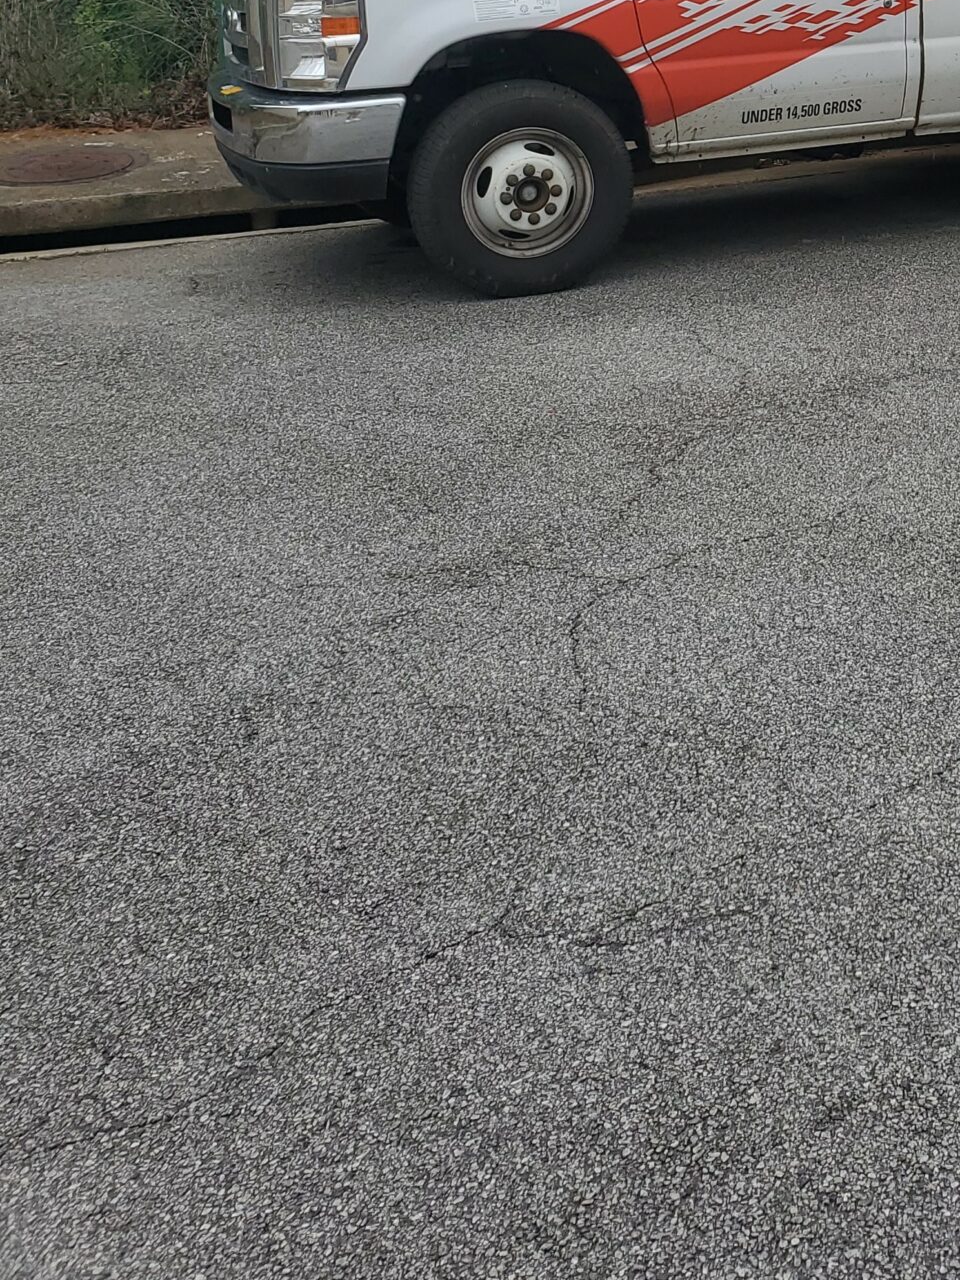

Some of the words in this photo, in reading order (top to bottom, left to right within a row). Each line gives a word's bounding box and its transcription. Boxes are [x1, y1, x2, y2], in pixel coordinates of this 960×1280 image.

[741, 107, 783, 124] UNDER
[785, 104, 820, 121] 14,500
[823, 98, 862, 115] GROSS
